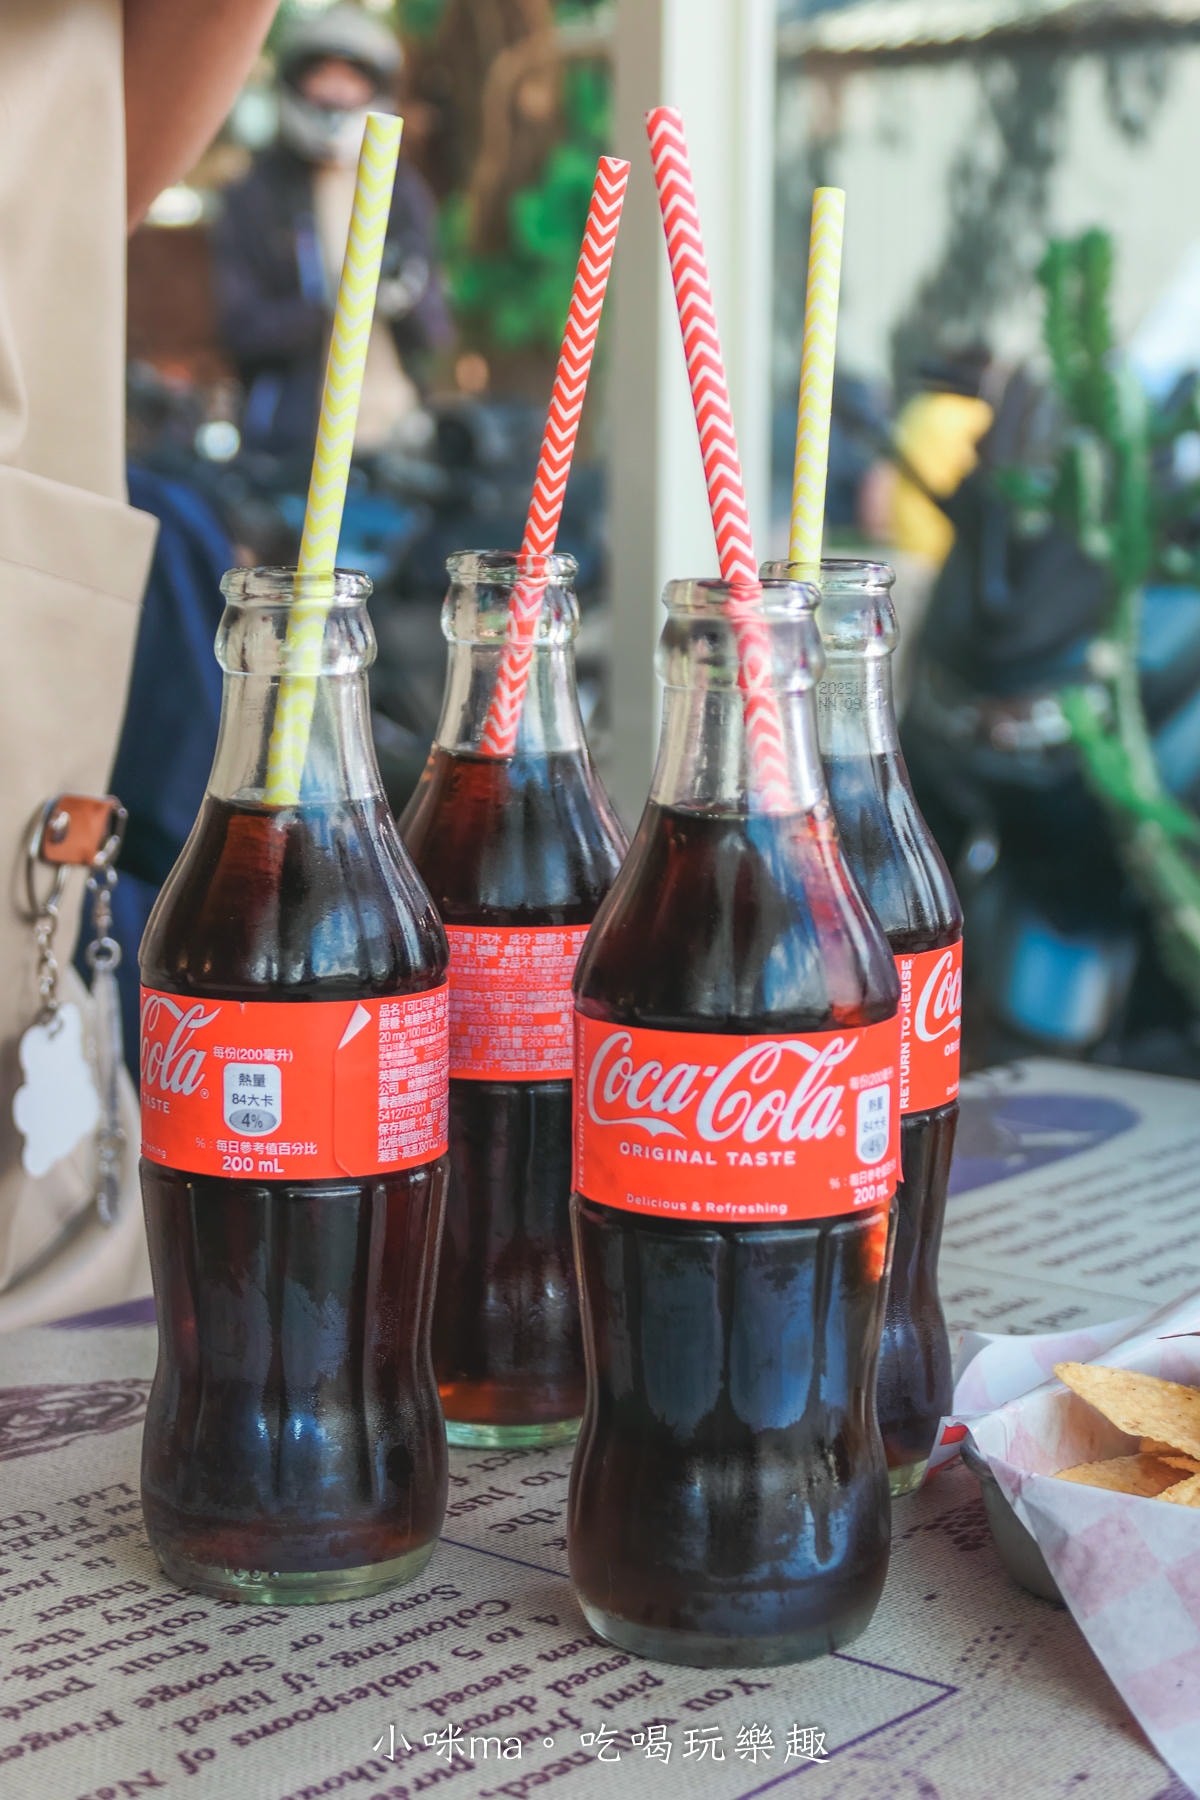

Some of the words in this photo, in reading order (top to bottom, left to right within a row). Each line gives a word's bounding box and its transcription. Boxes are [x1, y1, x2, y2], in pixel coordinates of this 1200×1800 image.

[901, 1017, 911, 1039] TO
[238, 1073, 266, 1087] 熱量
[379, 1082, 399, 1096] 公司
[587, 1031, 859, 1143] Coca-Cola
[900, 1043, 911, 1108] RETURN
[231, 1093, 274, 1107] 84大卡
[241, 1113, 264, 1129] 4%
[222, 1156, 254, 1172] 200
[258, 1159, 285, 1173] mL
[619, 1142, 717, 1166] ORIGINAL
[726, 1151, 797, 1167] TASTE
[626, 1193, 687, 1211] Delicious
[691, 1202, 701, 1212] &
[705, 1202, 788, 1216] Refreshing
[854, 1187, 877, 1206] 200
[33, 1580, 151, 1624] finger
[220, 1609, 290, 1637] the
[315, 1598, 512, 1671] Colouring,
[486, 1625, 525, 1645] to
[3, 1609, 209, 1682] colouring.
[109, 1638, 210, 1678] fruit
[288, 1634, 325, 1654] or
[131, 1654, 276, 1711] Sponge
[281, 1671, 320, 1696] if
[591, 1669, 665, 1713] pint
[679, 1677, 772, 1714] You
[158, 1690, 278, 1738] liked.
[230, 1660, 441, 1749] tablespoons
[176, 1747, 218, 1777] of
